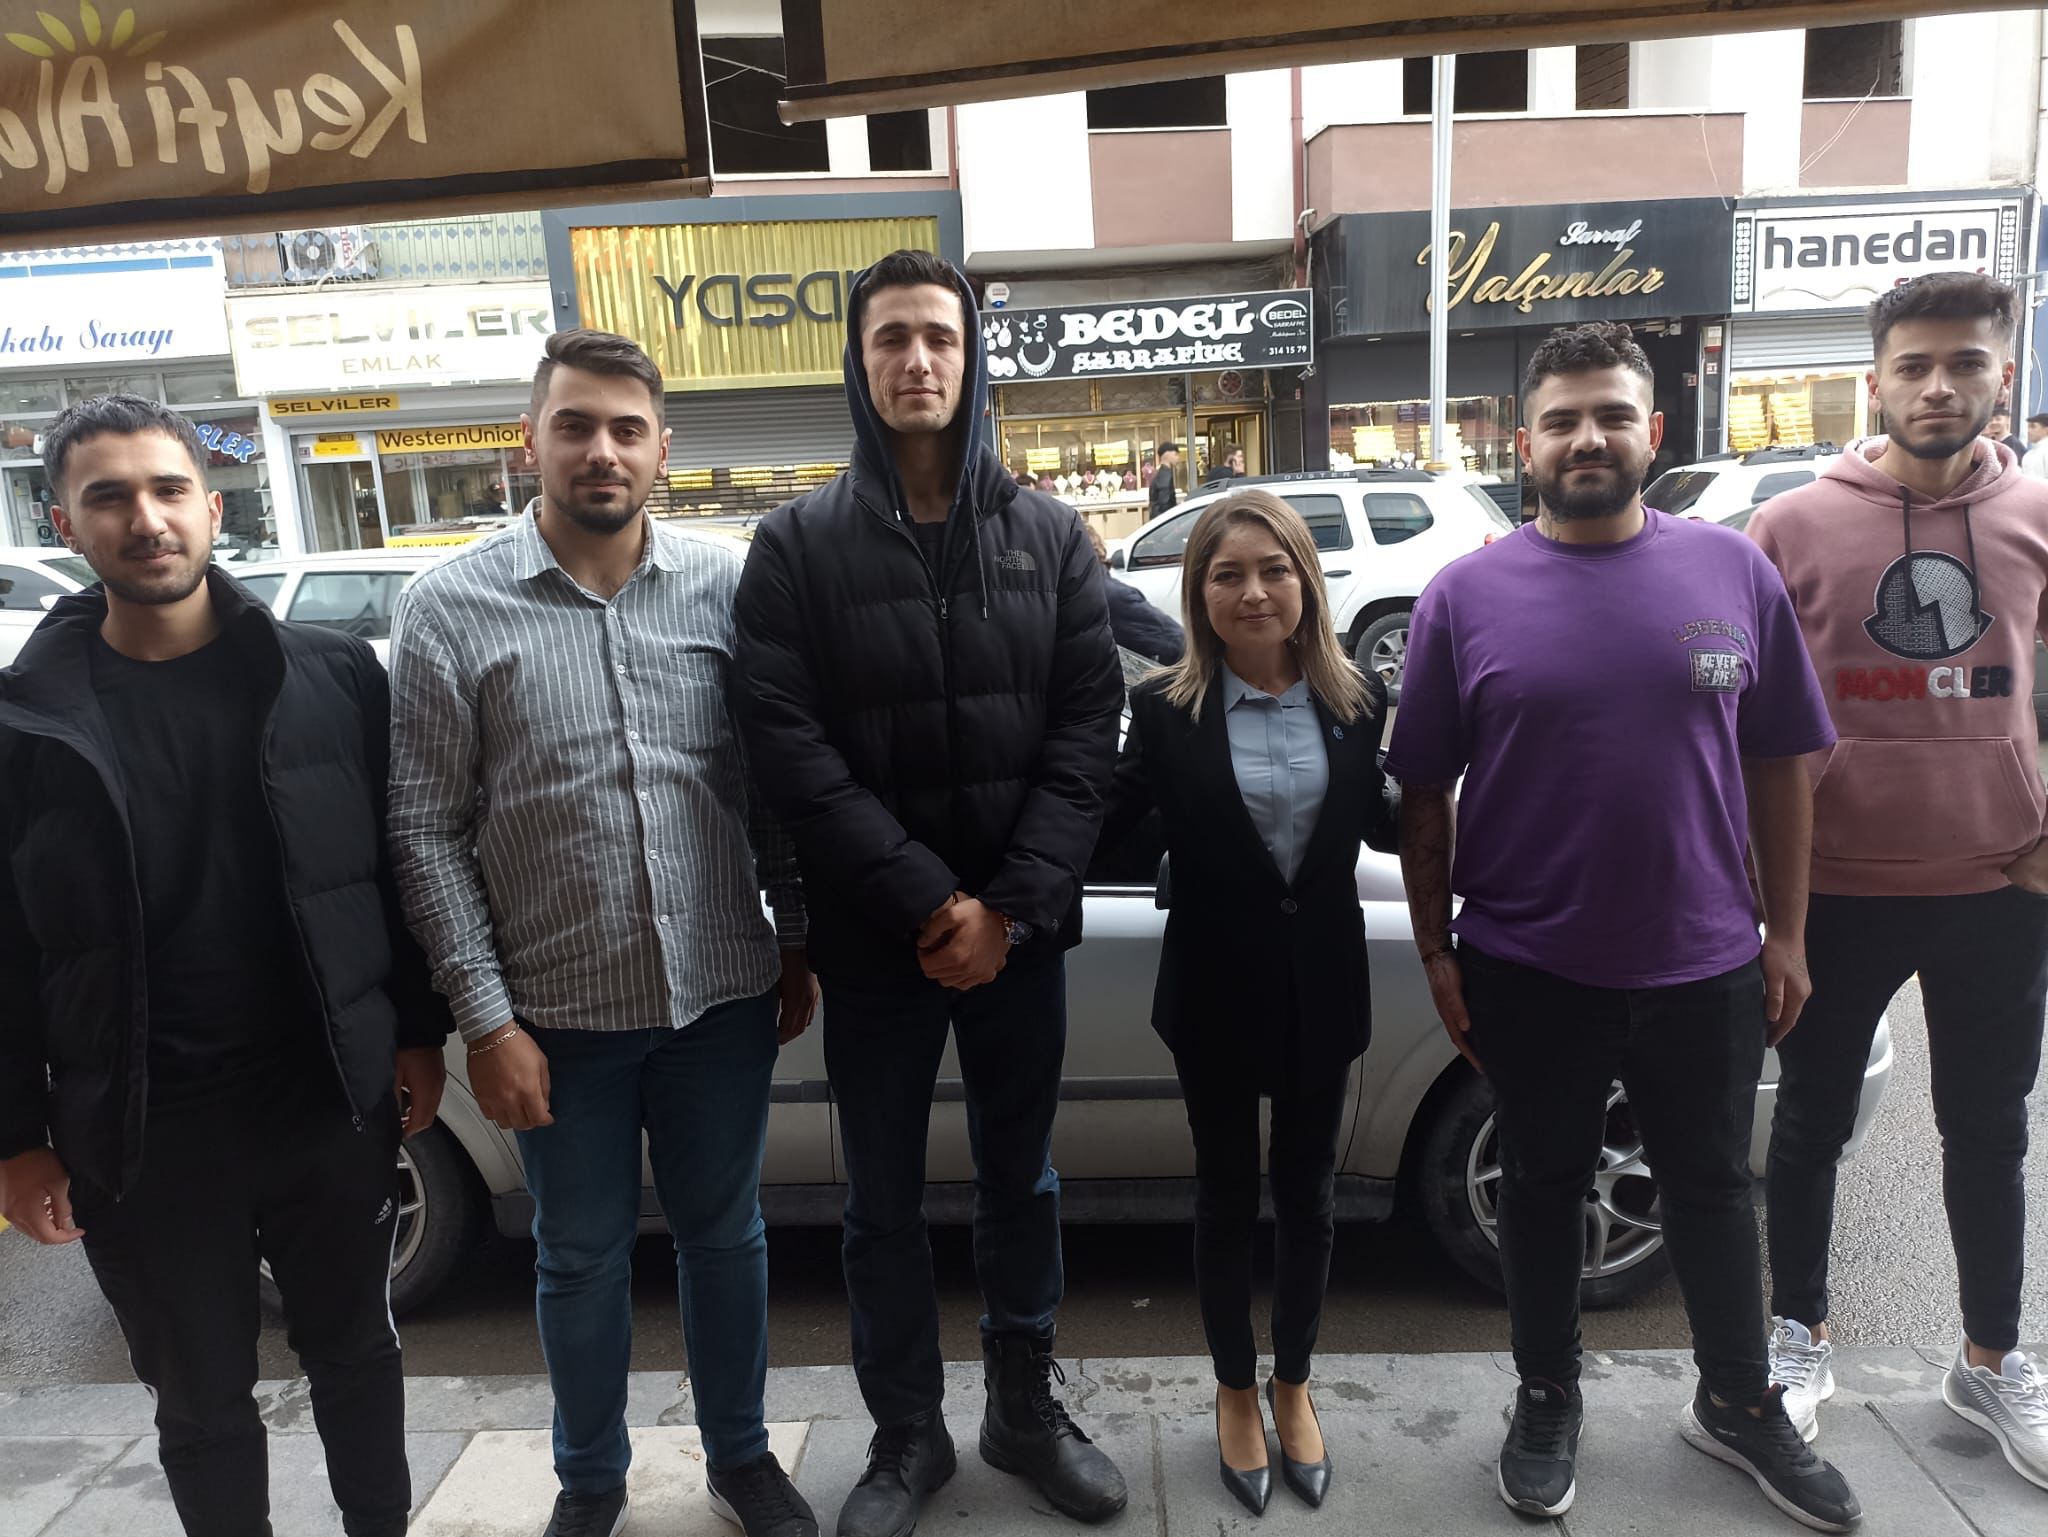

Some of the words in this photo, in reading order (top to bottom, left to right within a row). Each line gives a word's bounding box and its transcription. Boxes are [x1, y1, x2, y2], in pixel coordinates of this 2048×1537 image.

[1560, 219, 1643, 251] Sarraf
[1765, 220, 1987, 270] hanedan
[1058, 301, 1255, 348] BEDEL
[1269, 310, 1307, 320] BEDEL
[1268, 346, 1284, 356] 314
[1286, 345, 1296, 354] 15
[1296, 344, 1308, 354] 79
[342, 354, 442, 375] EMLAK
[1284, 471, 1351, 481] DUSTER
[1836, 666, 2013, 700] MONCLER
